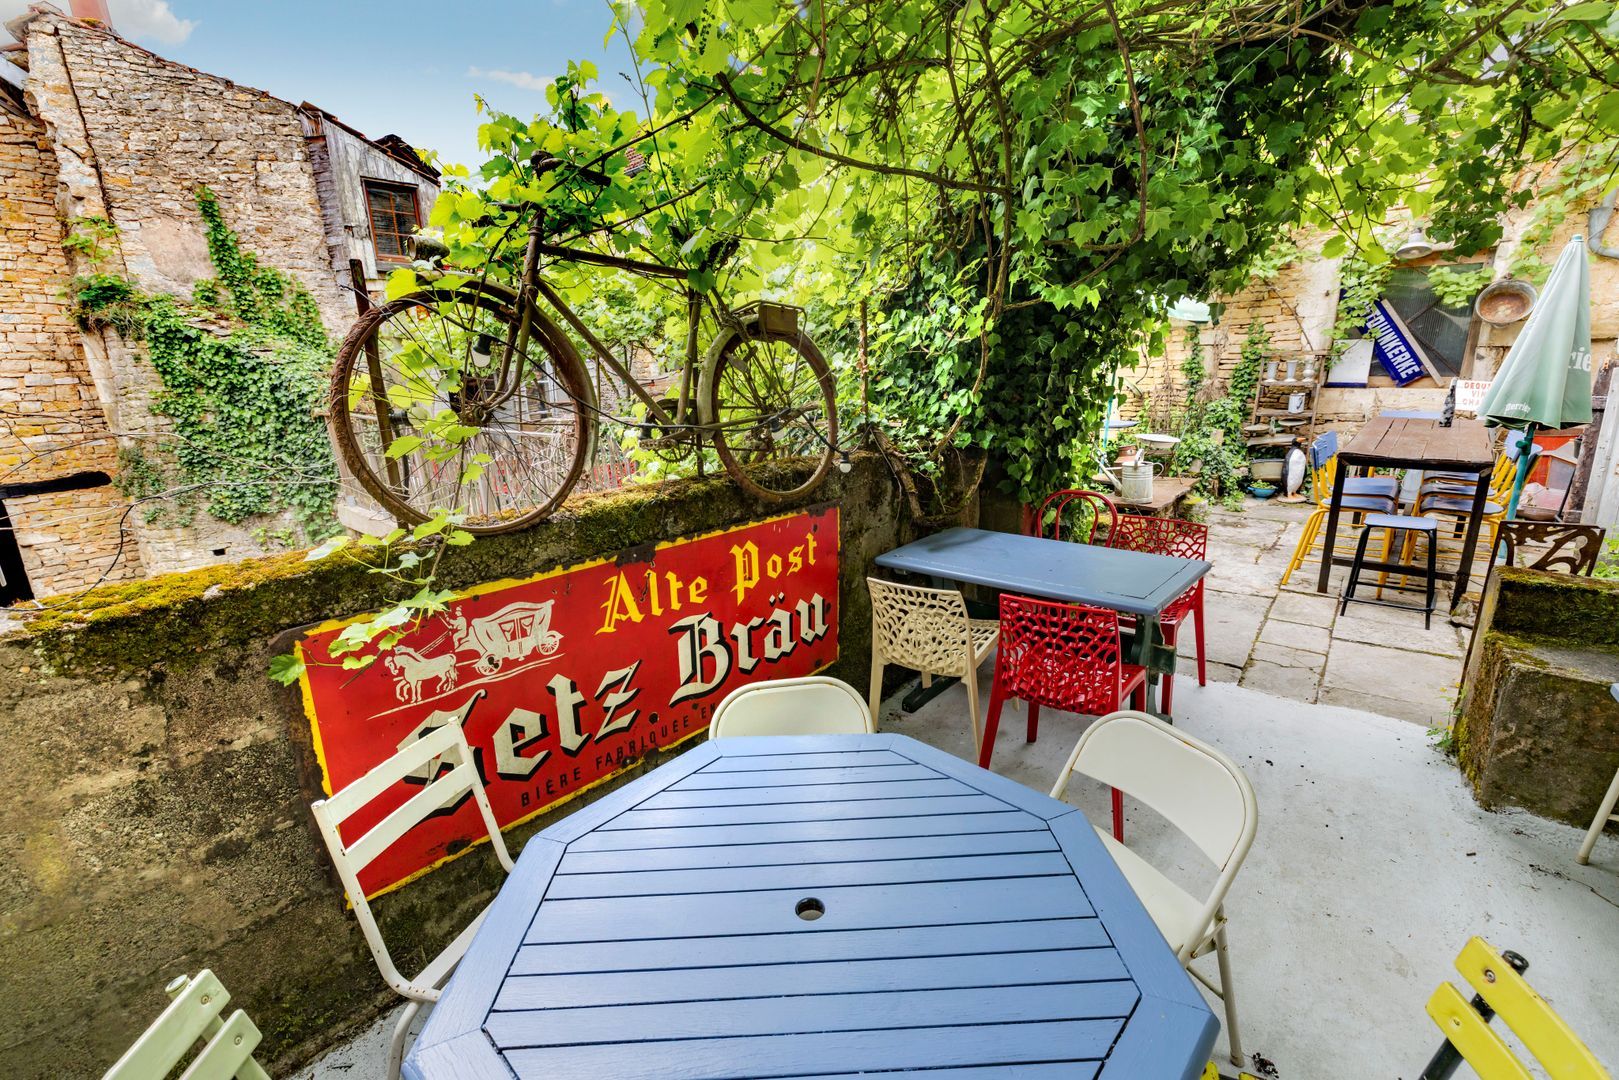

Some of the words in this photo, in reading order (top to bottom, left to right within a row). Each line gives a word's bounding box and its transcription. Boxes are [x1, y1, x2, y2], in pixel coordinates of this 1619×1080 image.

[595, 569, 708, 636] Alte
[729, 532, 817, 606] Post
[667, 591, 830, 708] Bräu
